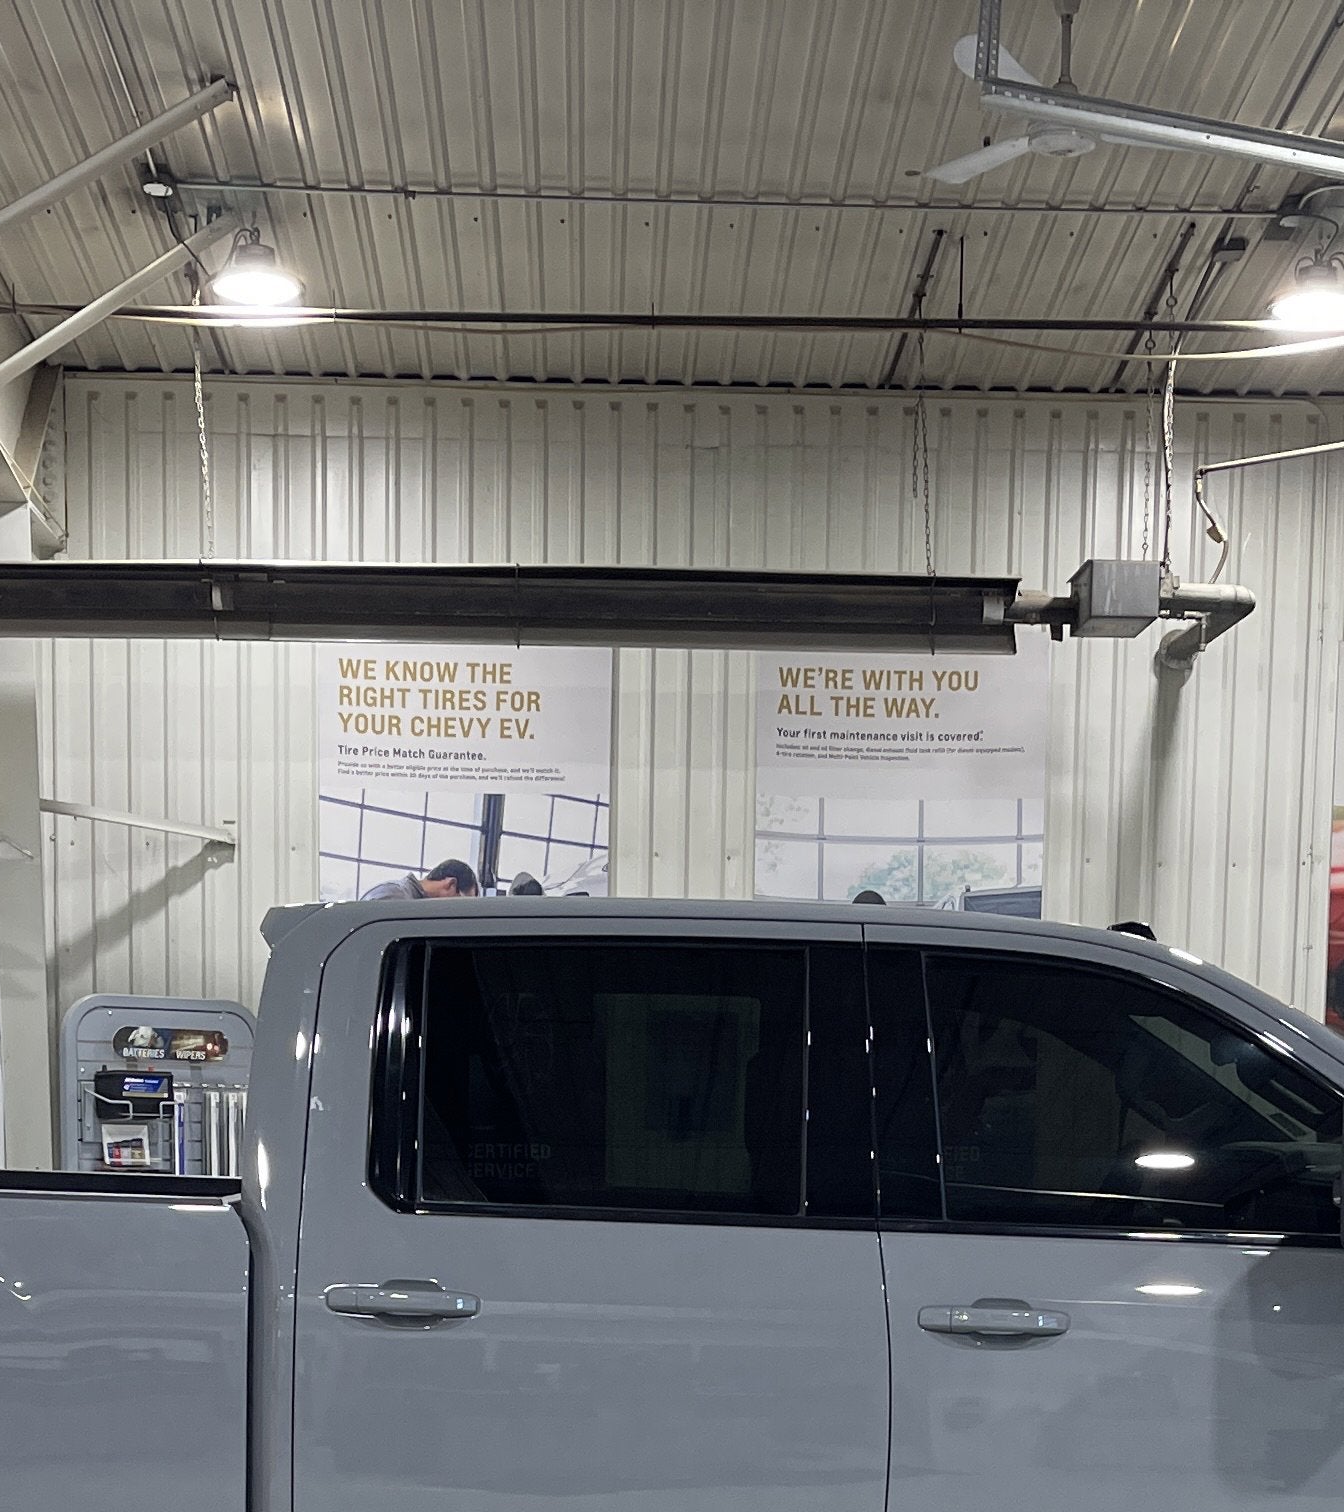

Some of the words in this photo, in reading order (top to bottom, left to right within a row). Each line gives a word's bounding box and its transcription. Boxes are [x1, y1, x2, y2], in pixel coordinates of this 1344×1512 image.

[339, 658, 376, 680] WE
[385, 660, 458, 683] KNOW
[466, 662, 512, 684] THE
[779, 667, 854, 690] WE'RE
[862, 669, 923, 691] WITH
[932, 671, 978, 692] YOU
[339, 685, 411, 709] RIGHT
[418, 688, 487, 711] TIRES
[496, 690, 541, 712] FOR
[777, 694, 822, 716] ALL
[830, 696, 875, 718] THE
[884, 697, 940, 719] WAY.
[338, 712, 401, 736] YOUR
[411, 716, 491, 738] CHEVY
[500, 718, 535, 739] EV.
[777, 728, 801, 738] Your
[804, 728, 827, 739] first
[830, 730, 898, 741] maintenance
[901, 731, 923, 741] visit
[926, 731, 935, 741] is
[338, 745, 358, 755] Tire
[362, 746, 390, 757] Price
[393, 748, 425, 759] Match
[428, 749, 487, 760] Guarantee.
[122, 1047, 165, 1058] BATTERIES
[176, 1049, 206, 1060] WIPERS
